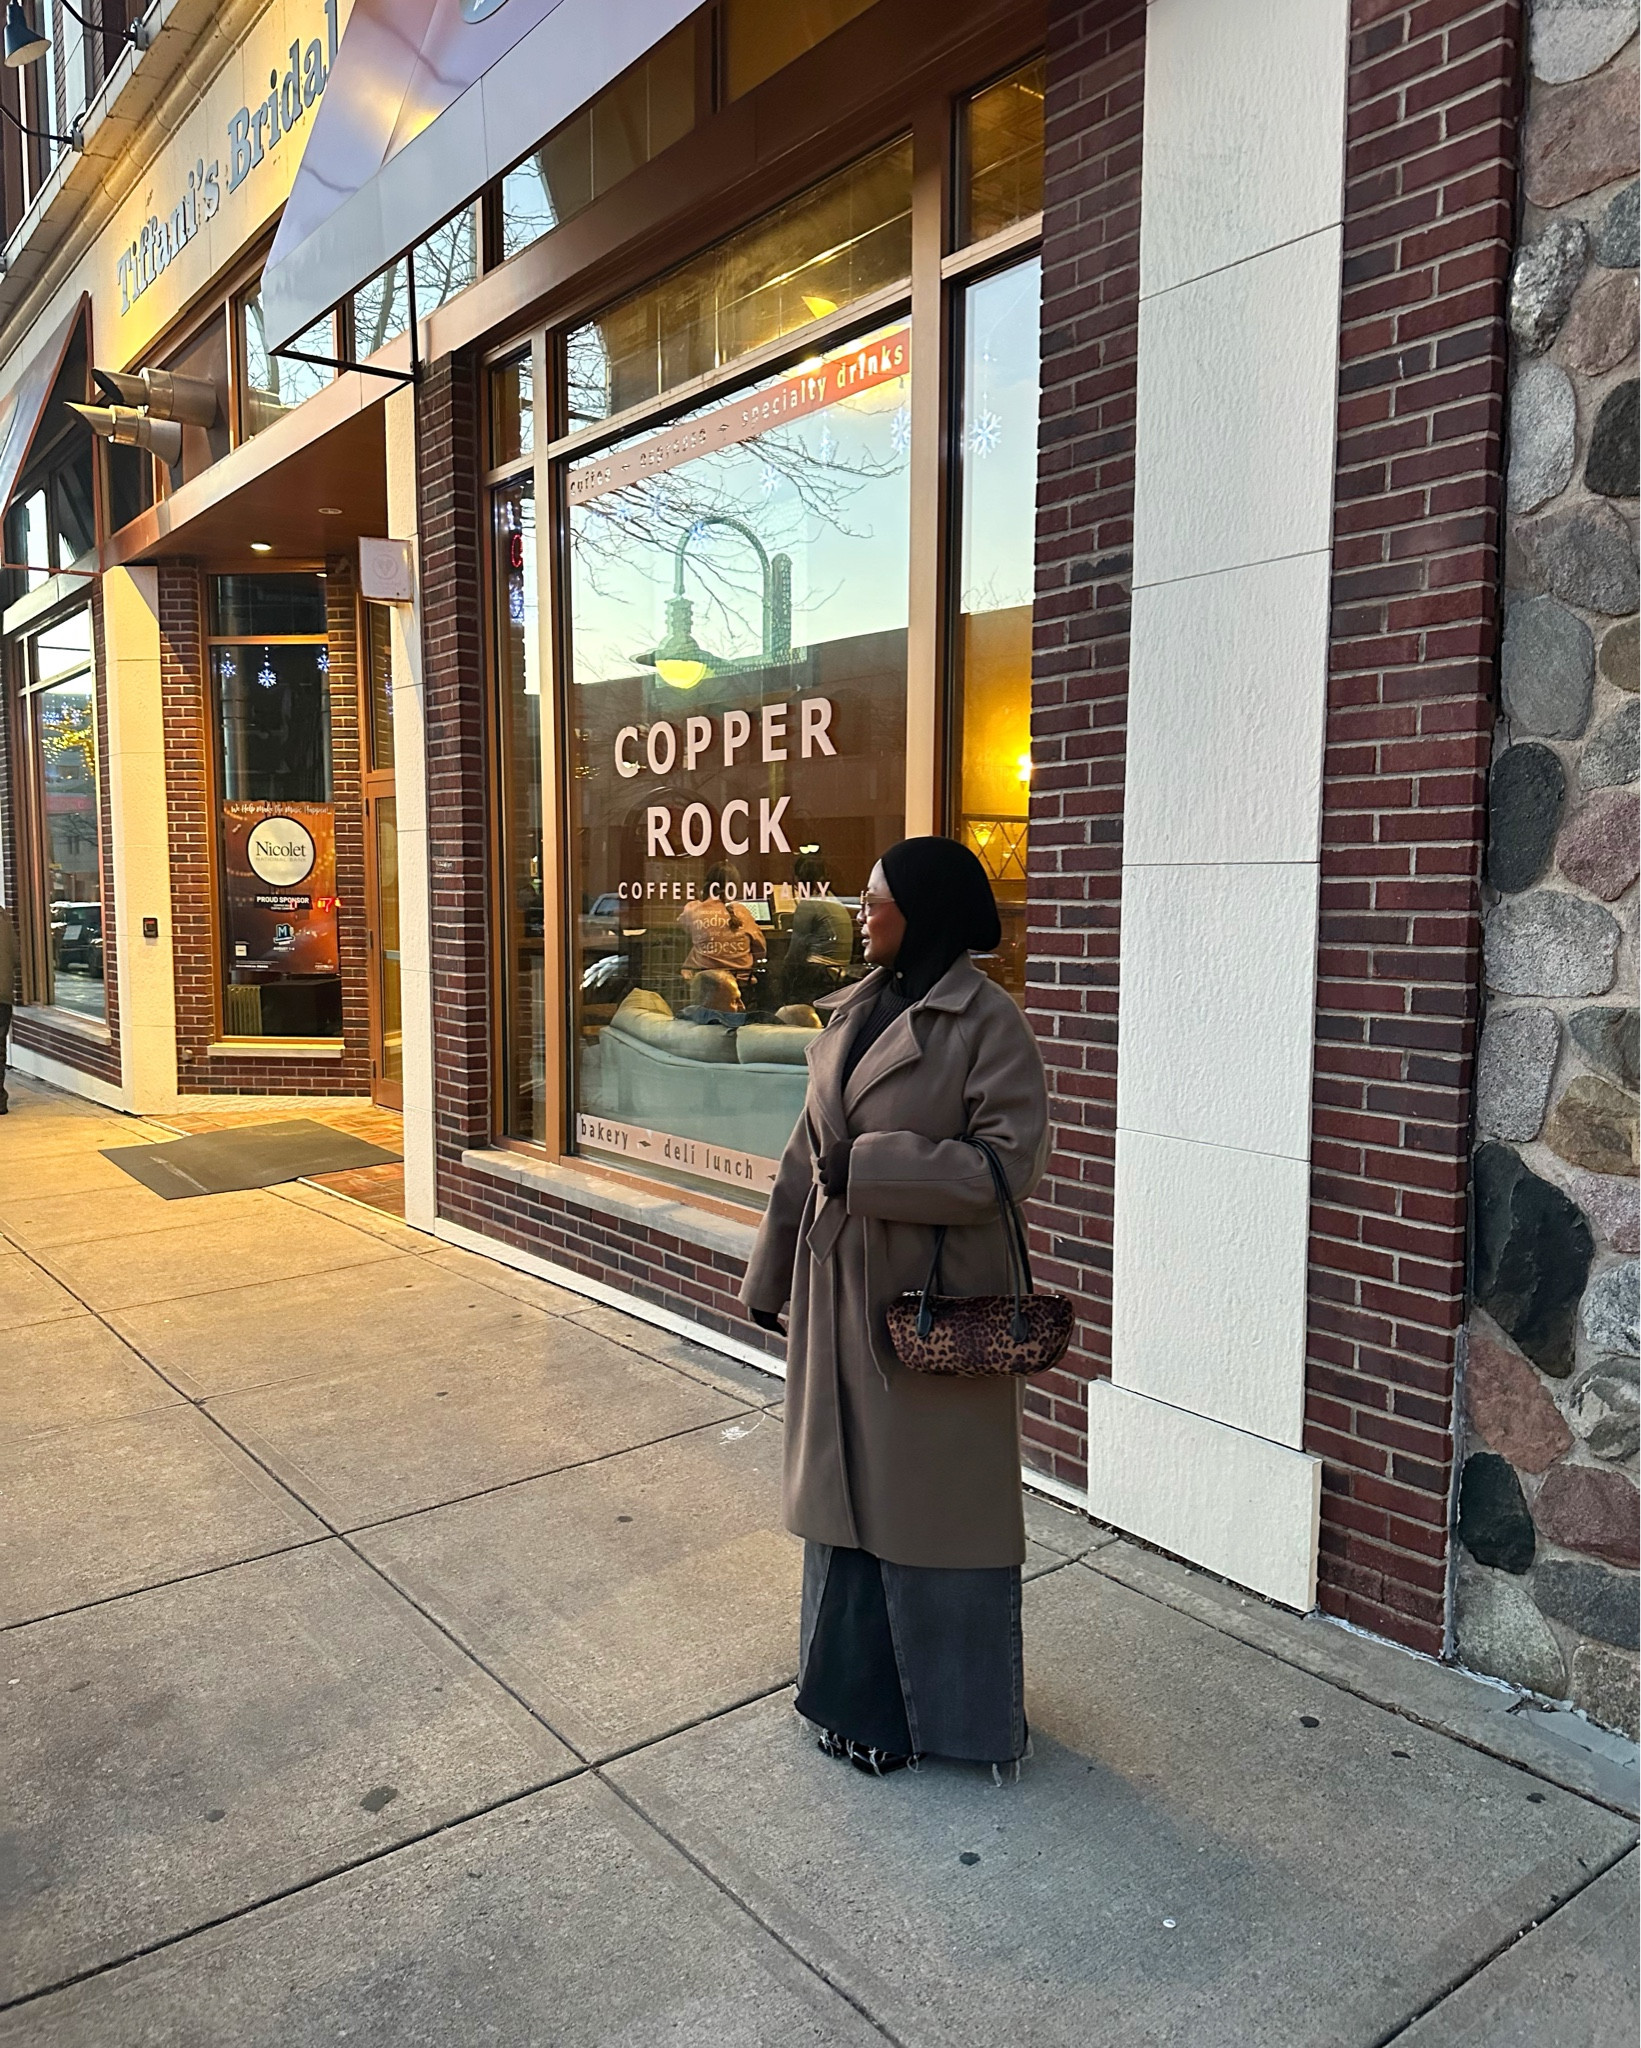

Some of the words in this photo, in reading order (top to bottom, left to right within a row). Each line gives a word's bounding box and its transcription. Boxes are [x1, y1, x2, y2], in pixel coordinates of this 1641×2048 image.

[117, 158, 220, 317] Tiffani's
[227, 0, 338, 194] Bridal
[742, 376, 827, 429] specialty
[837, 345, 904, 389] drinks
[614, 697, 837, 778] COPPER
[256, 841, 306, 857] Nicolet
[647, 796, 791, 857] ROCK
[279, 896, 310, 904] SPONSOR
[618, 882, 695, 900] COFFEE
[709, 881, 831, 900] COMPANY
[581, 1119, 629, 1150] bakery
[664, 1139, 696, 1165] deli
[705, 1148, 754, 1180] lunch
